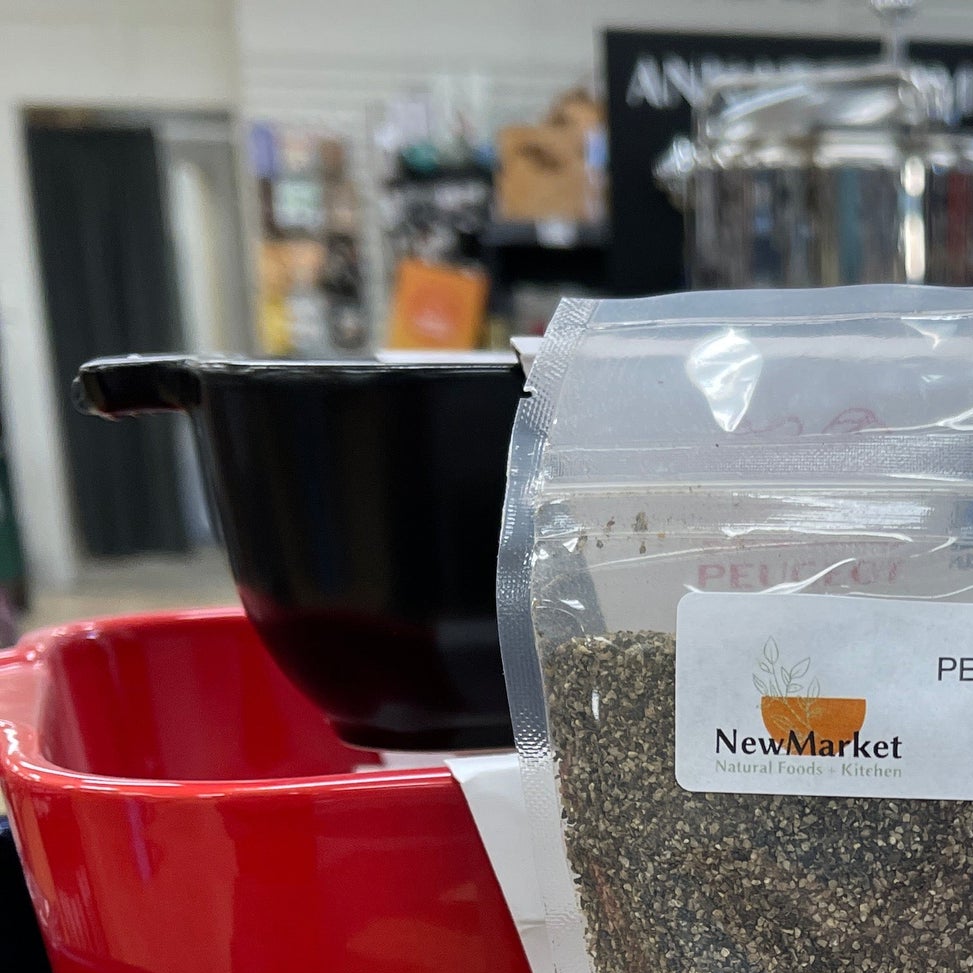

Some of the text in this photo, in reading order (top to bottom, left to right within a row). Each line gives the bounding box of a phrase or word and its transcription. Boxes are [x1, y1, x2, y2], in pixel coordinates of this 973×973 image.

[715, 728, 902, 759] NewMarket
[715, 760, 772, 774] Natural
[778, 761, 823, 776] Foods
[841, 763, 902, 778] Kitchen
